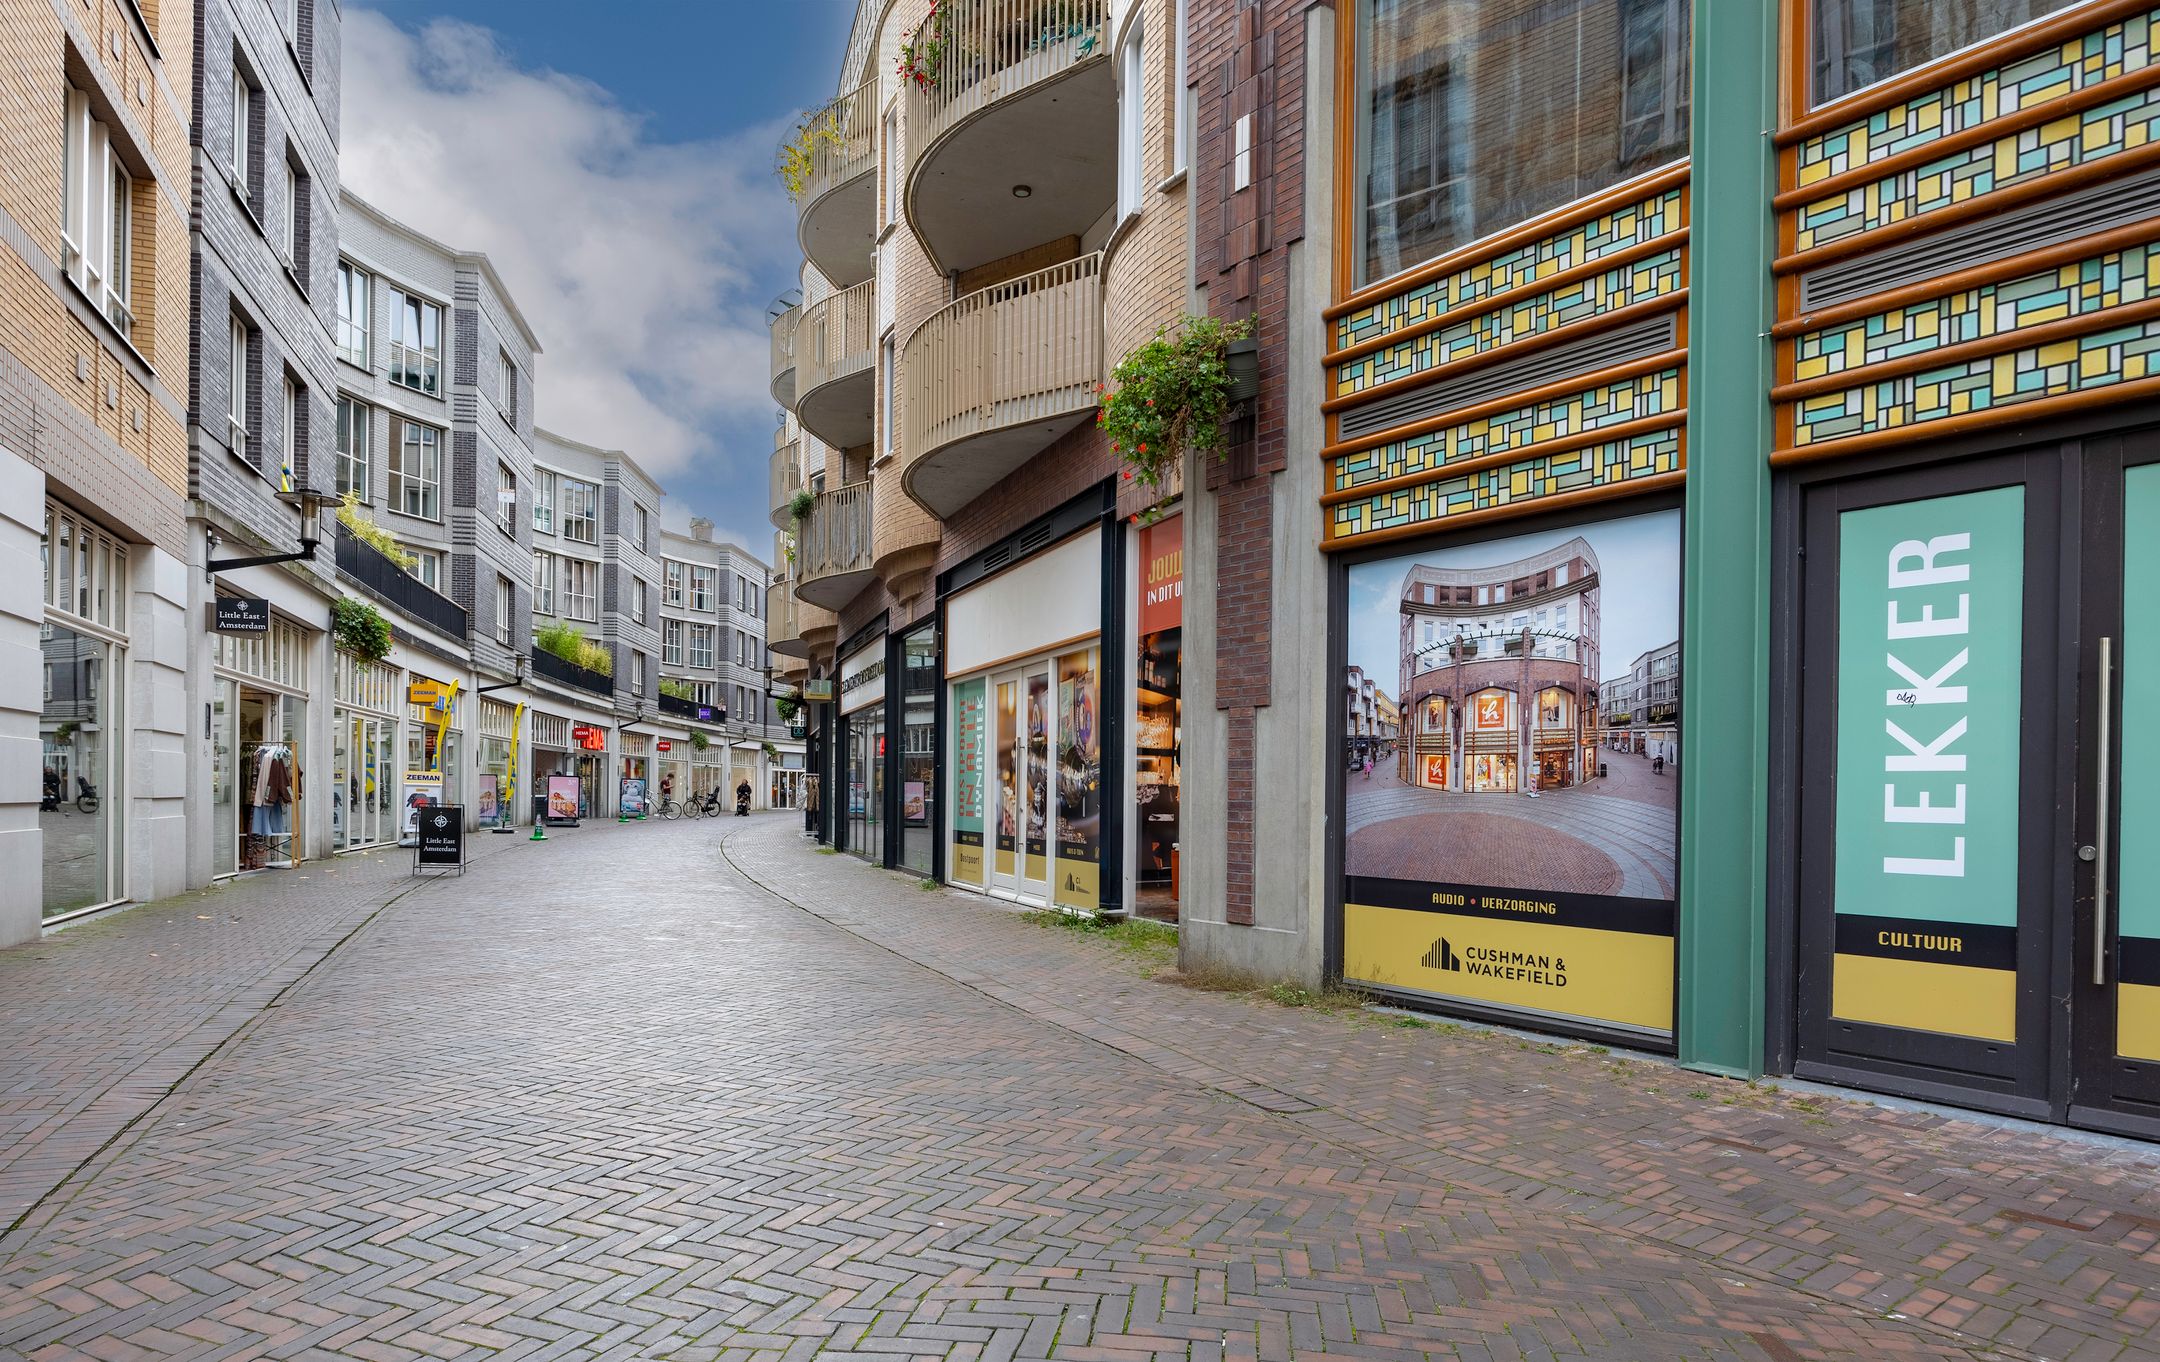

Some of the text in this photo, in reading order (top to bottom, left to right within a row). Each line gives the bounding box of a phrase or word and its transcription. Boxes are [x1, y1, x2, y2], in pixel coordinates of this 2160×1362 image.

[1147, 589, 1157, 606] IN
[1159, 583, 1174, 603] DIT
[219, 610, 241, 619] Little
[243, 612, 261, 620] East
[219, 621, 266, 630] Amsterdam
[1883, 532, 1971, 877] LEKKER
[966, 696, 976, 772] ALLE
[976, 695, 984, 818] DYNAMIEK
[1432, 892, 1557, 915] AUDIO VERZORGING
[1878, 931, 1962, 953] CULTUUR
[1466, 946, 1566, 971] CUSHMAN &
[1466, 961, 1567, 987] WAKEFIELD
